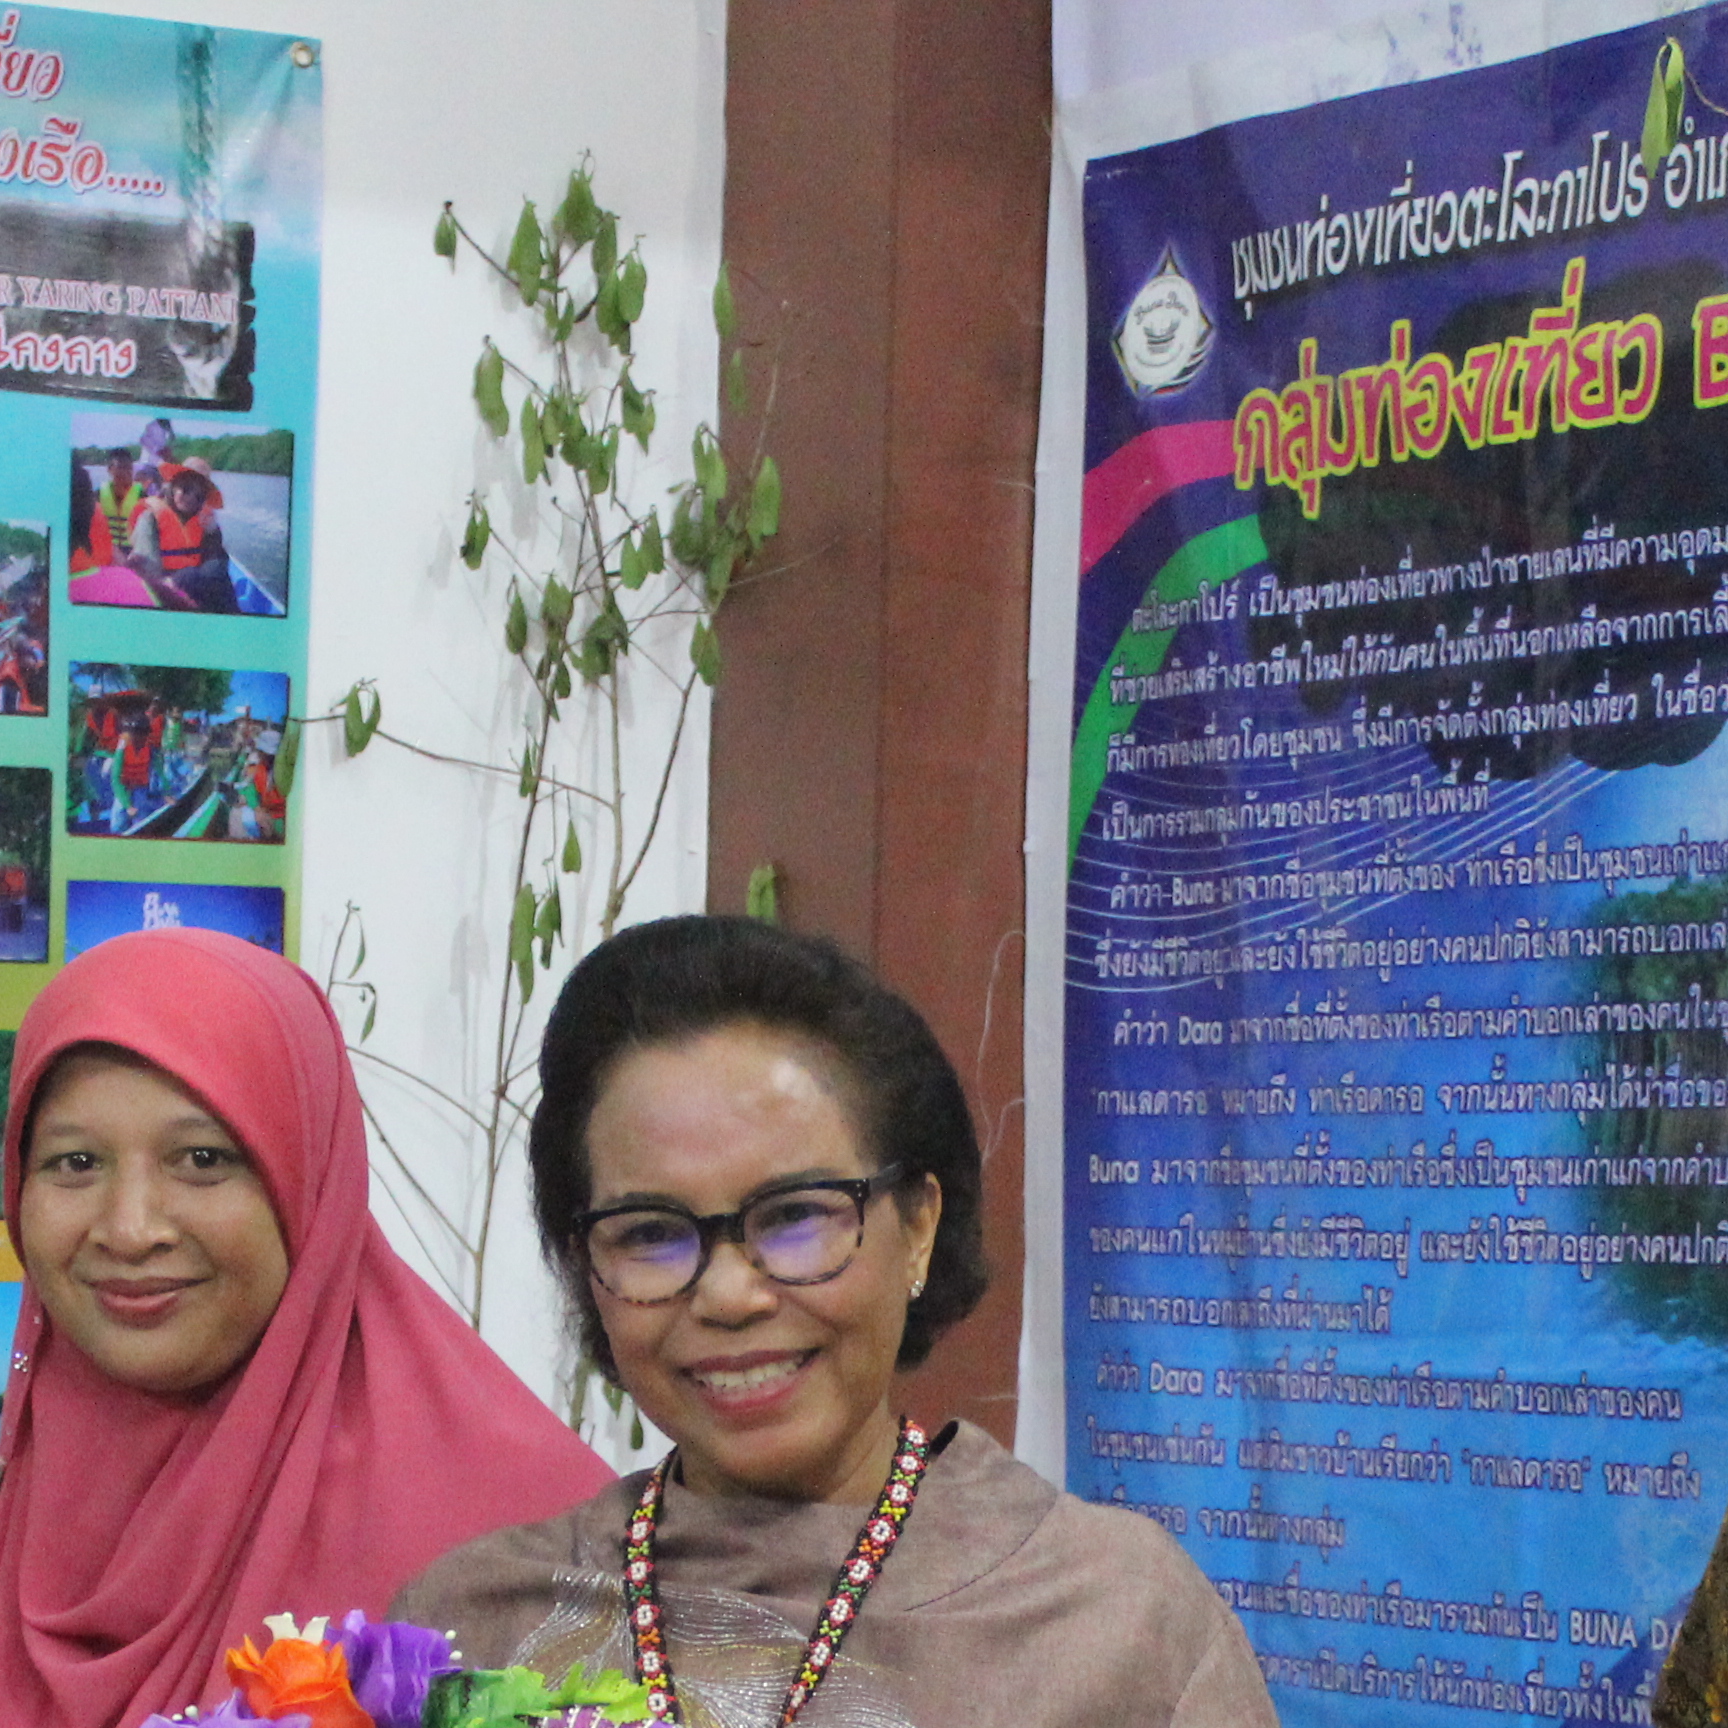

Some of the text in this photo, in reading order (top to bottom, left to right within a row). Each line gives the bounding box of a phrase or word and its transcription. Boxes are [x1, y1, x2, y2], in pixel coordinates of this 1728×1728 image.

[17, 275, 121, 316] YARING
[1233, 256, 1665, 519] กลุ่มท่องเที่ยว
[1177, 1015, 1222, 1046] Dara
[1088, 1154, 1140, 1185] Buna
[1149, 1359, 1204, 1397] Dara
[1603, 1451, 1702, 1501] หมายถึง
[1569, 1608, 1638, 1649] BUNA
